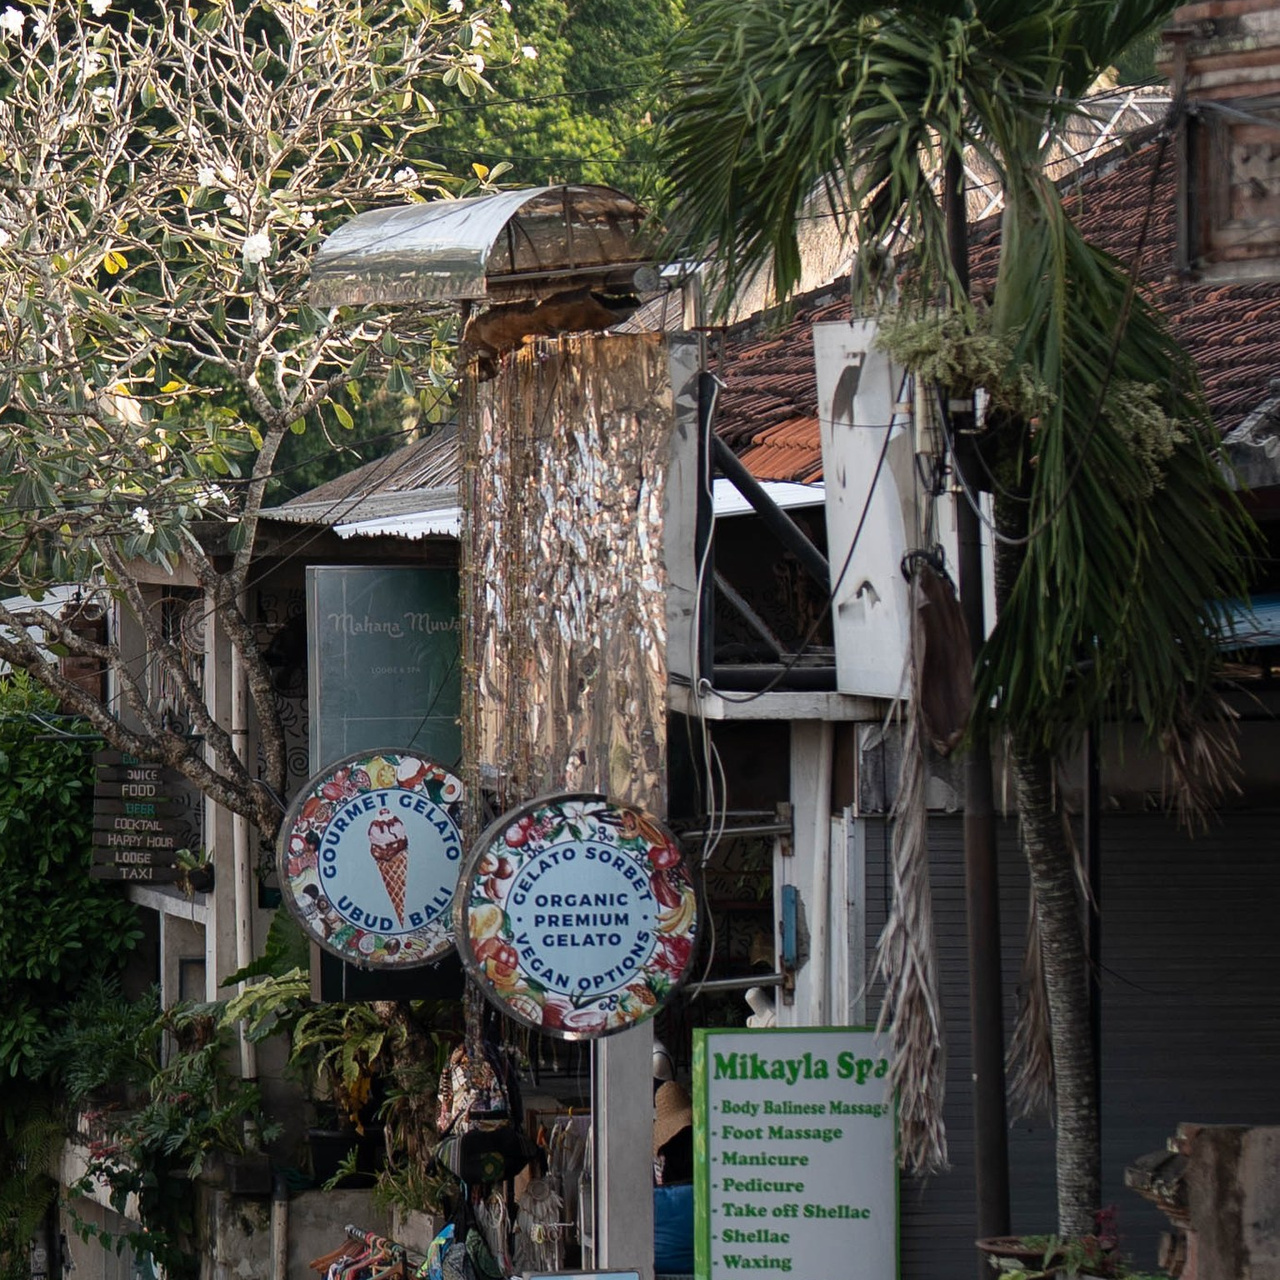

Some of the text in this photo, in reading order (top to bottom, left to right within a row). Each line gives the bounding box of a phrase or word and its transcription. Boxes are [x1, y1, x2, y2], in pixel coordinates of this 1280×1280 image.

[328, 613, 404, 638] Mahana
[127, 770, 158, 780] JUICE
[121, 784, 156, 797] FOOD
[115, 818, 163, 831] COCKTAIL
[107, 834, 173, 847] HAPPY HOUR
[323, 793, 460, 878] GOURMET GELATO
[115, 852, 152, 864] LODGE
[120, 867, 153, 879] TAXI
[513, 847, 652, 906] GELATO SORBET
[535, 893, 629, 908] ORGANIC
[337, 887, 452, 931] UBUD BALI
[534, 913, 630, 927] PREMIUM
[542, 933, 622, 947] GELATO
[516, 930, 650, 991] VEGAN OPTIONS
[713, 1051, 889, 1086] Mikayla Spa
[721, 1099, 889, 1118] Body Balinese Massage
[722, 1125, 843, 1142] Foot Massage
[722, 1151, 809, 1166] Manicure
[722, 1177, 805, 1193] Pedicure
[722, 1203, 871, 1219] Take off Shellac
[722, 1228, 790, 1244] Shellac
[723, 1254, 793, 1272] Waxing
